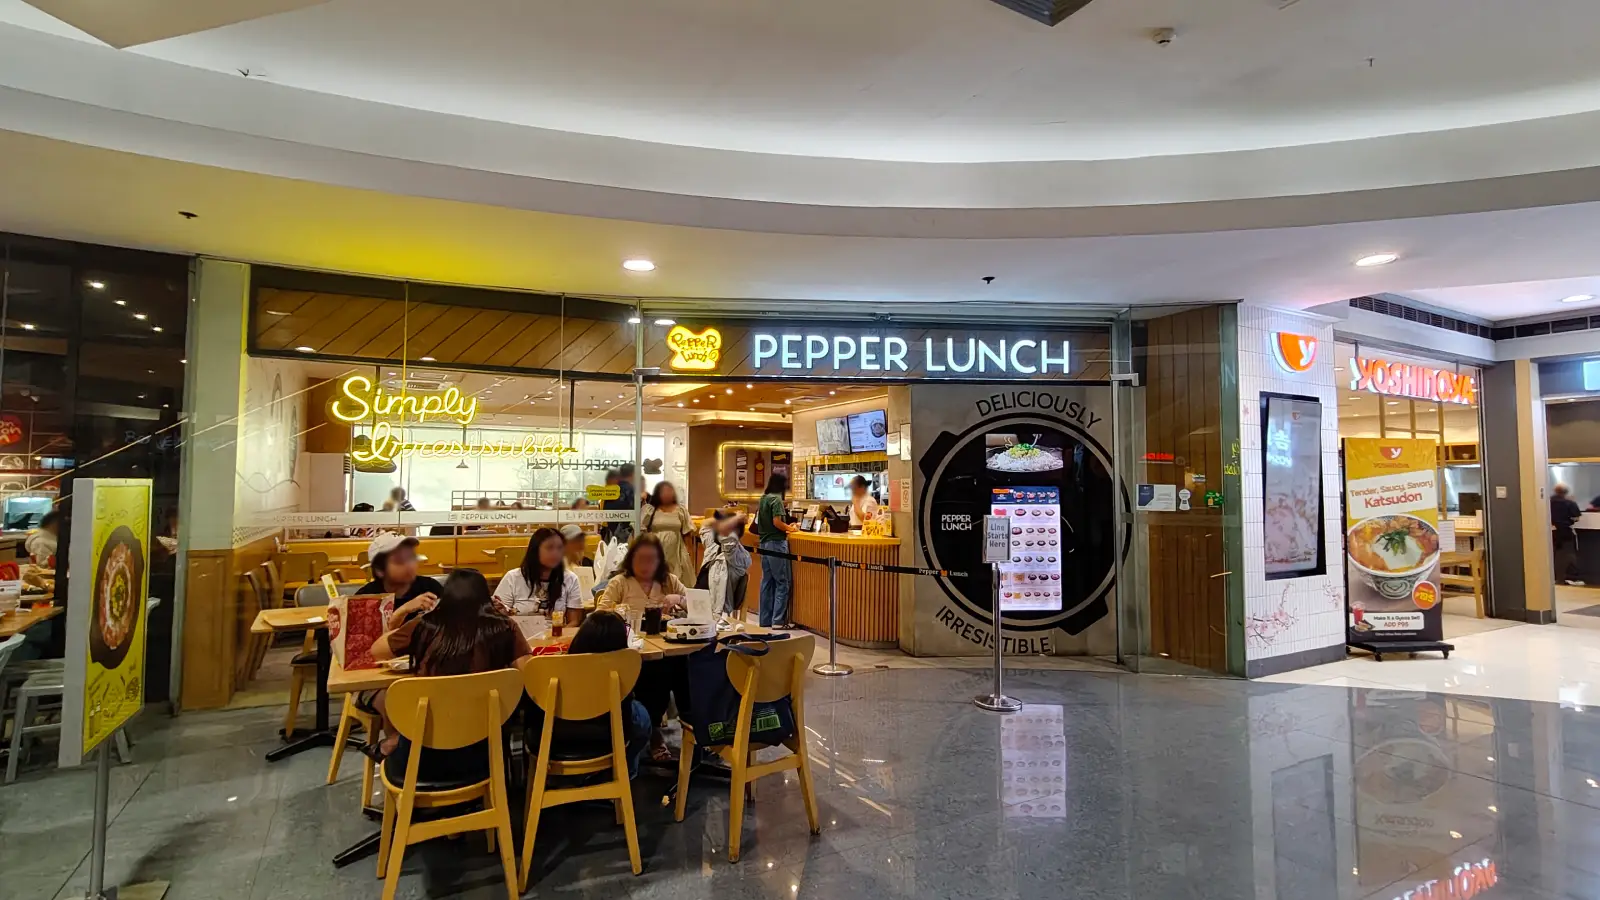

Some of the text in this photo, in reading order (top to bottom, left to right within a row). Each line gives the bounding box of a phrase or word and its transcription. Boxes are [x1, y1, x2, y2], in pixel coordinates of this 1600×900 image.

[753, 333, 1070, 374] PEPPER LUNCH
[1349, 356, 1476, 404] YOSHINOYA
[331, 375, 478, 424] Simply
[975, 390, 1102, 429] DELICIOUSLY
[1364, 491, 1423, 508] Katsudon
[941, 514, 971, 523] PEPPER
[941, 523, 972, 531] LUNCH
[989, 540, 1006, 548] Here
